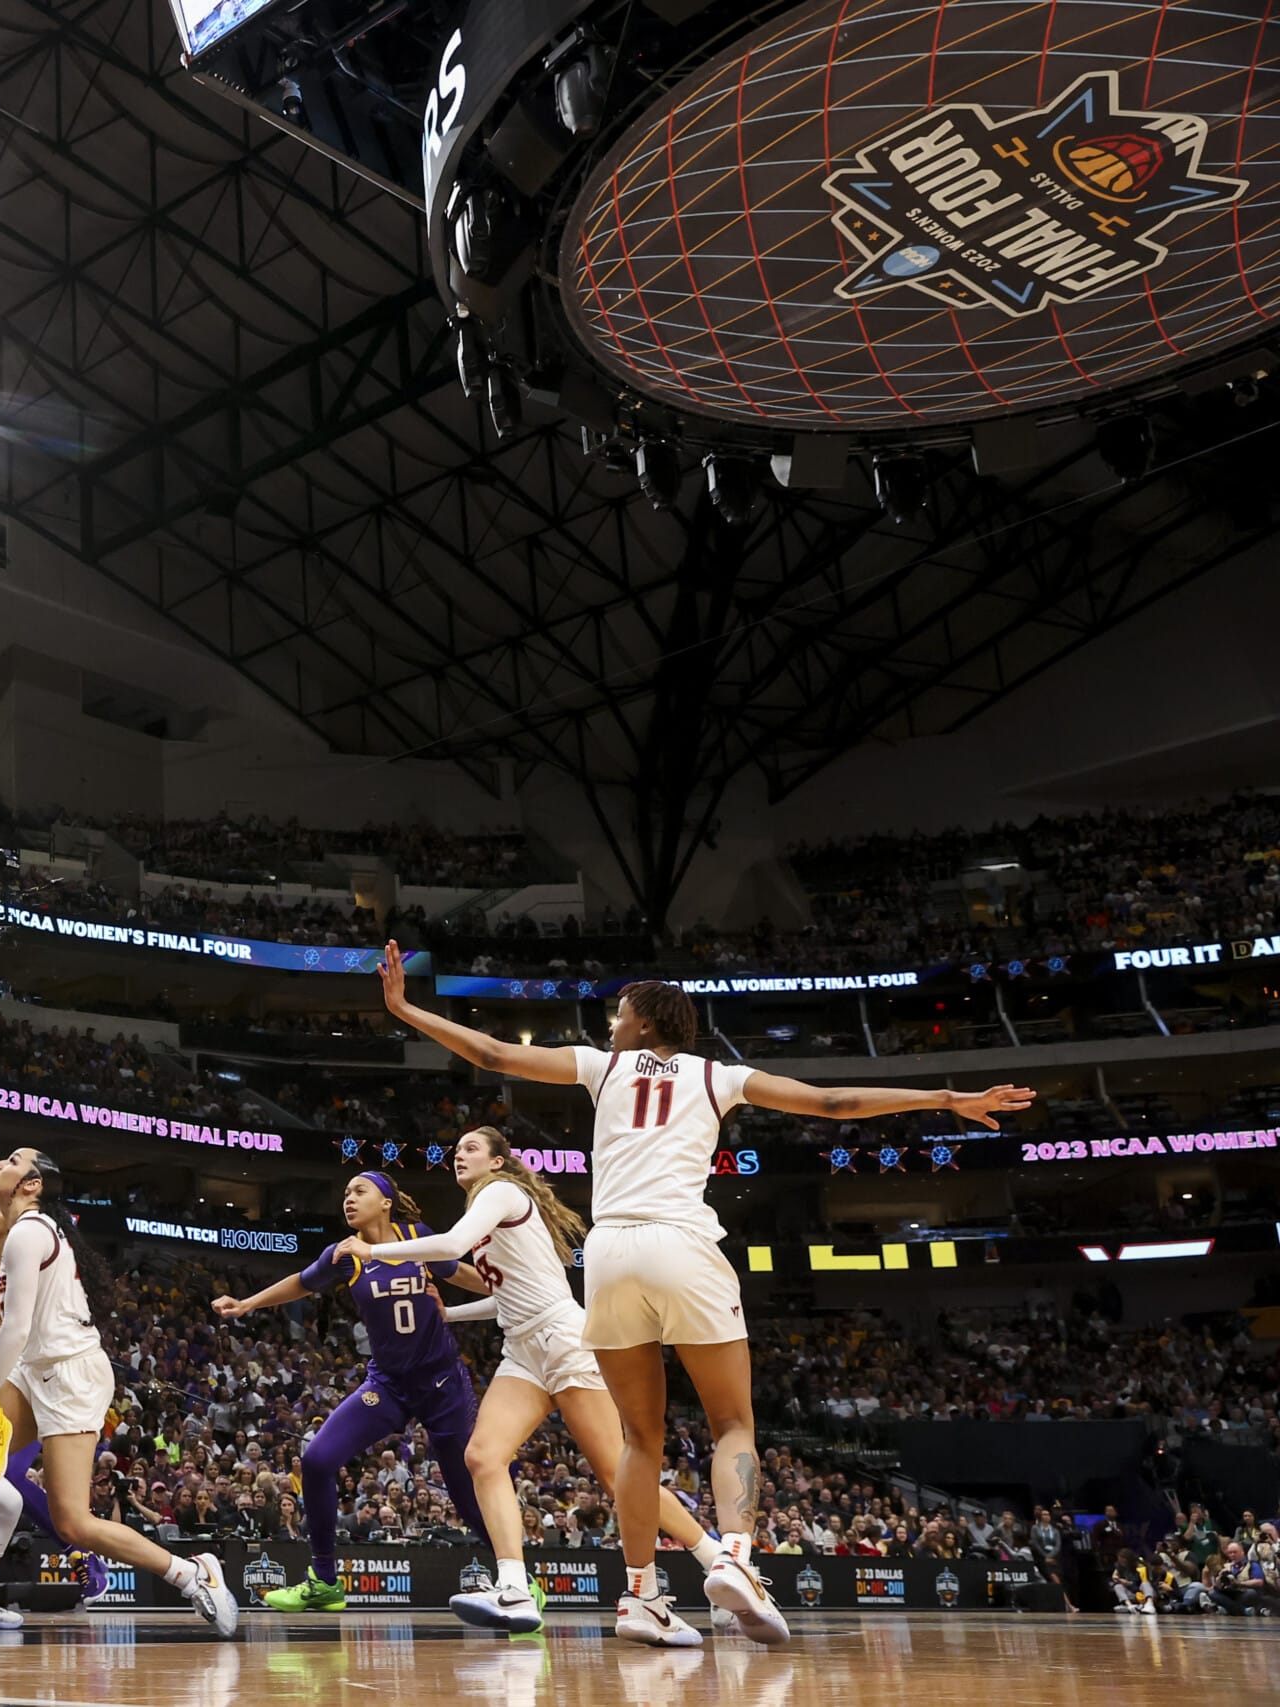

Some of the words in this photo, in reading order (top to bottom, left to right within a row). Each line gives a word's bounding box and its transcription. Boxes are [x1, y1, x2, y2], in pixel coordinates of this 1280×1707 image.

[422, 28, 466, 192] RS
[889, 119, 1024, 229] FOUR
[1029, 172, 1084, 211] DALLAS
[905, 207, 965, 252] WOMEN'S
[961, 249, 1002, 272] 2023
[982, 207, 1141, 291] FINAL
[56, 918, 145, 946] WOMEN'S
[147, 931, 201, 952] FINAL
[203, 939, 252, 959] FOUR
[1114, 945, 1189, 970] FOUR
[1192, 944, 1222, 963] IT
[681, 980, 730, 993] NCAA
[731, 977, 813, 992] WOMEN'S
[814, 975, 867, 990] FINAL
[868, 972, 919, 988] FOUR
[631, 1077, 675, 1130] 11
[23, 1093, 78, 1121] NCAA
[79, 1104, 168, 1137] WOMEN'S
[170, 1121, 225, 1146] FINAL
[227, 1130, 284, 1152] FOUR
[1022, 1143, 1089, 1161] 2023
[1090, 1135, 1167, 1158] NCAA
[126, 1218, 185, 1240] VIRGINIA
[185, 1226, 219, 1244] TECH
[221, 1228, 298, 1254] HOKIES
[370, 1277, 427, 1299] LSU
[393, 1300, 416, 1335] 0
[367, 1560, 410, 1573] DALLAS
[560, 1563, 598, 1575] DALLAS
